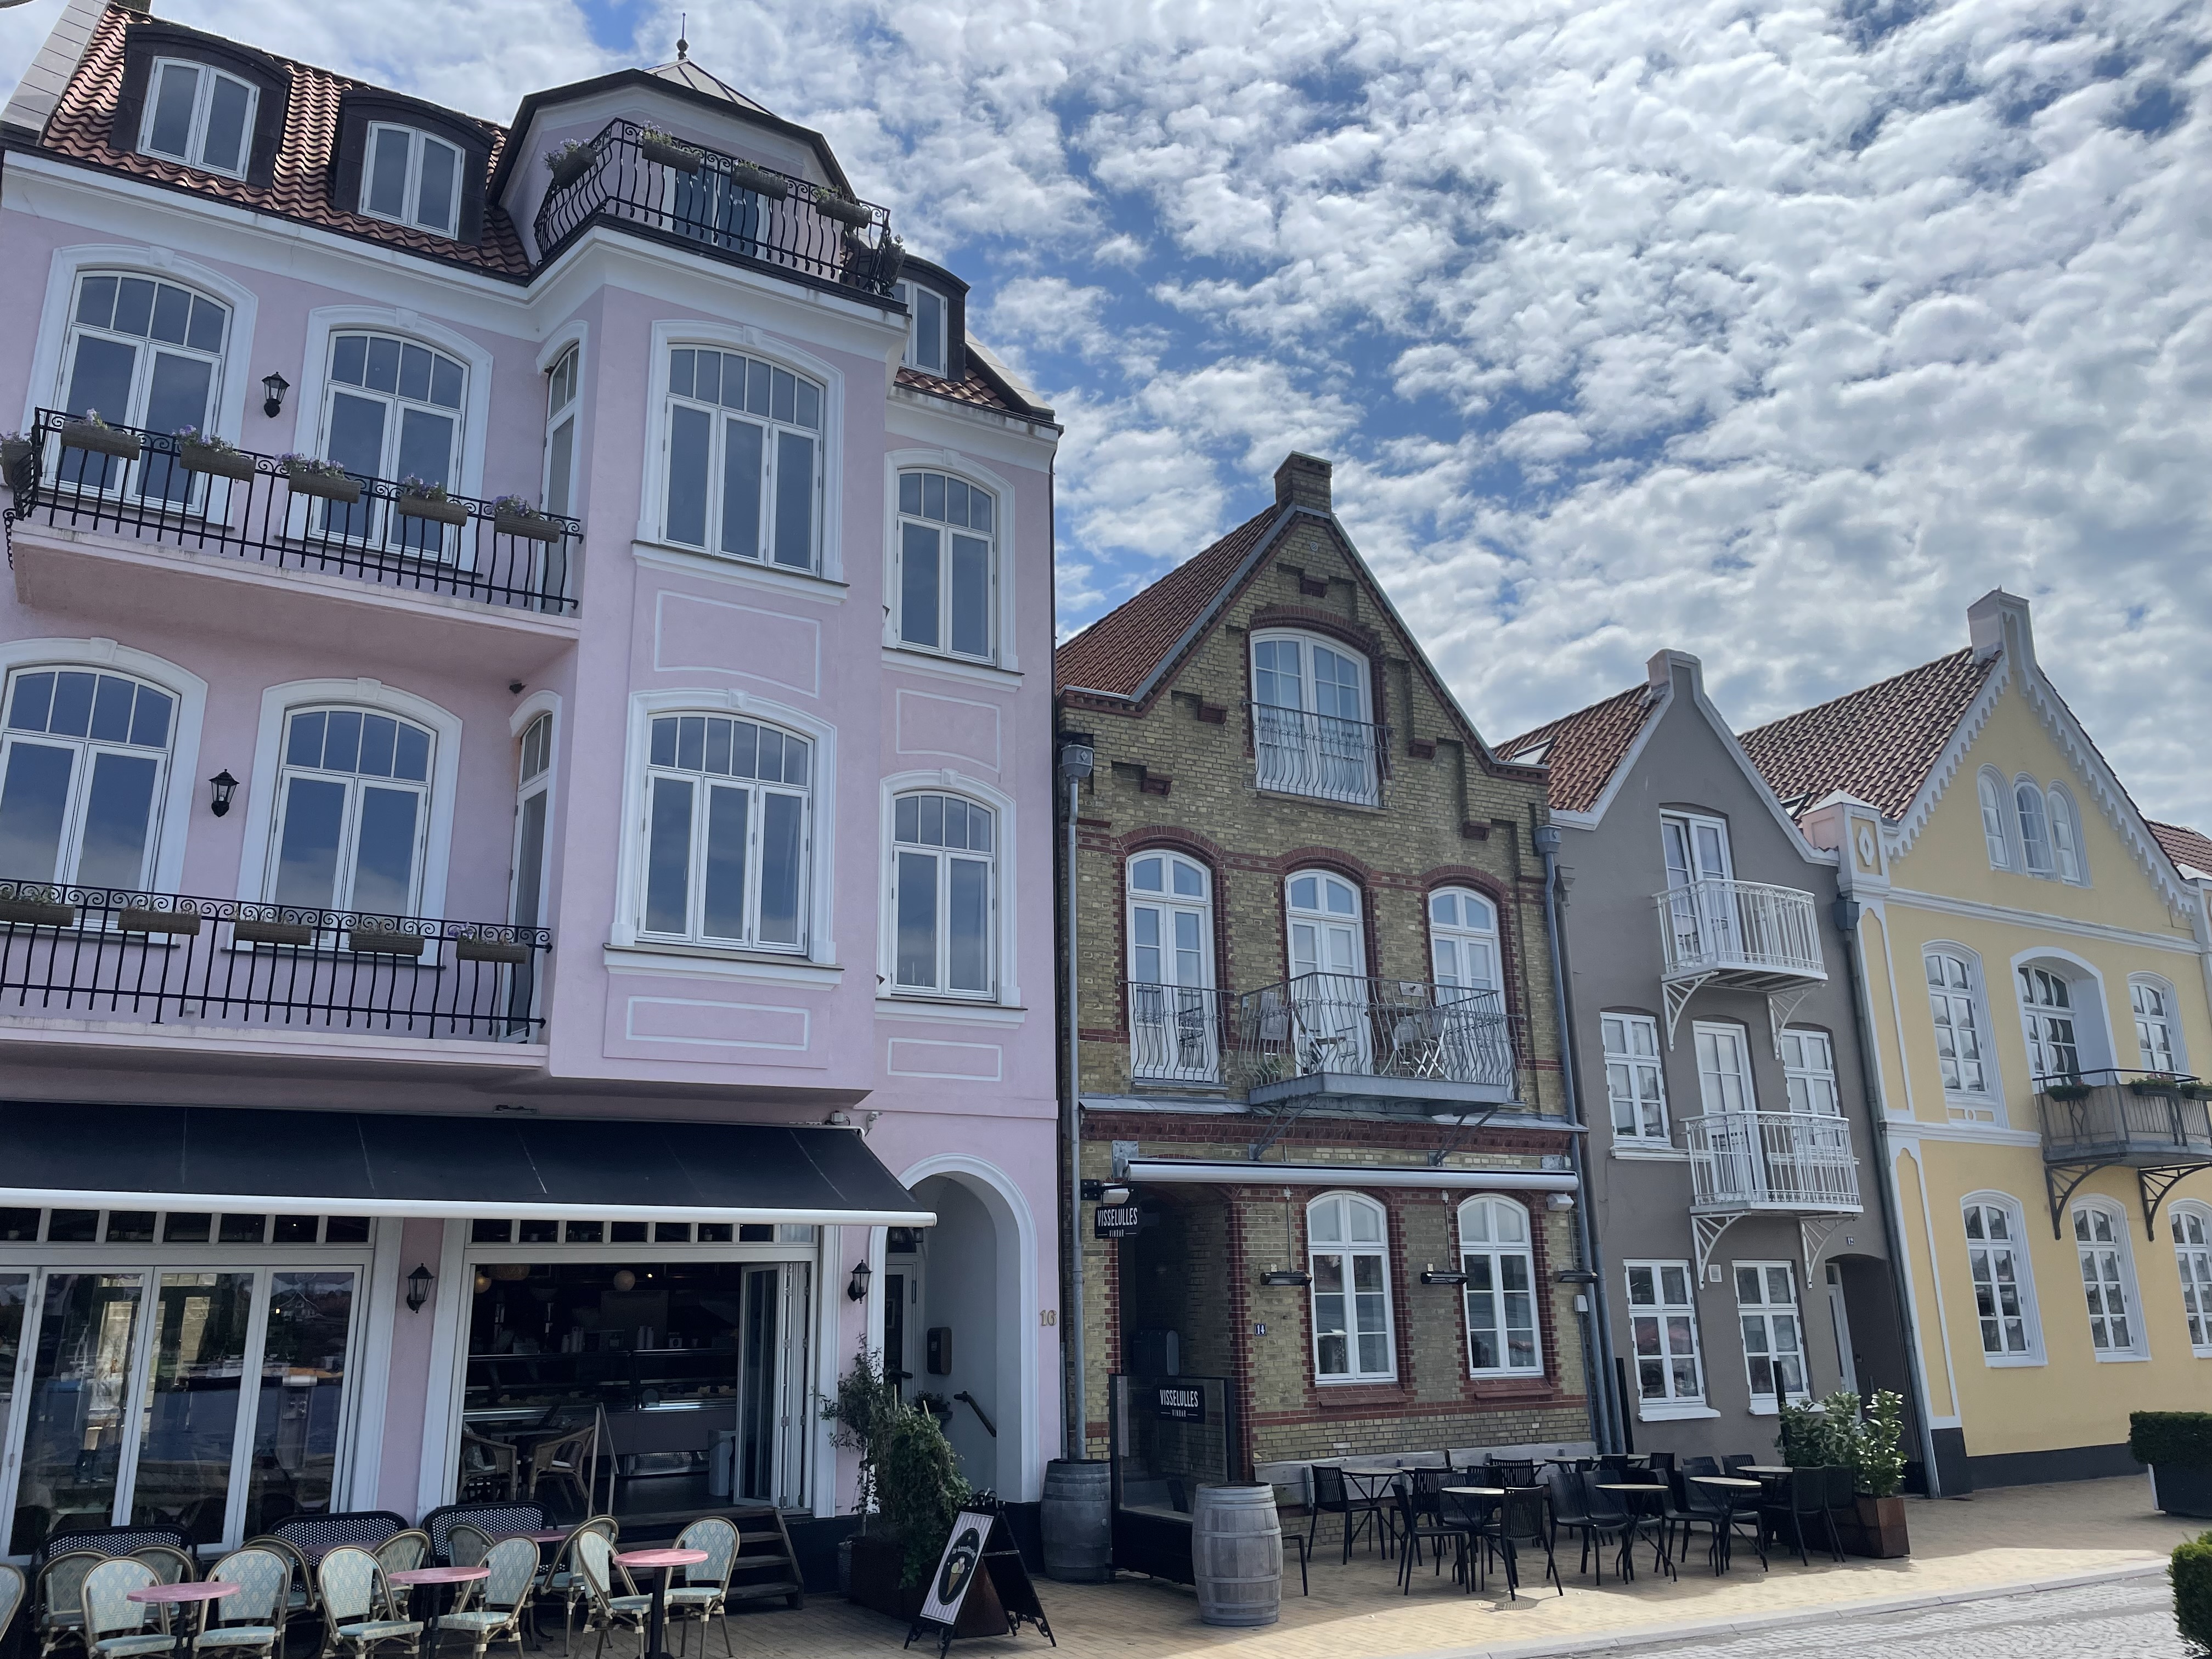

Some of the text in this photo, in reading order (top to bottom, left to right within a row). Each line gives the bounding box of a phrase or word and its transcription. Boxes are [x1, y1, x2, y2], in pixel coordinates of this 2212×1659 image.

[1097, 1207, 1138, 1227] VISSELULLES
[1040, 1310, 1057, 1326] 16
[1257, 1324, 1265, 1335] 14
[1160, 1389, 1198, 1407] VISSELULLES
